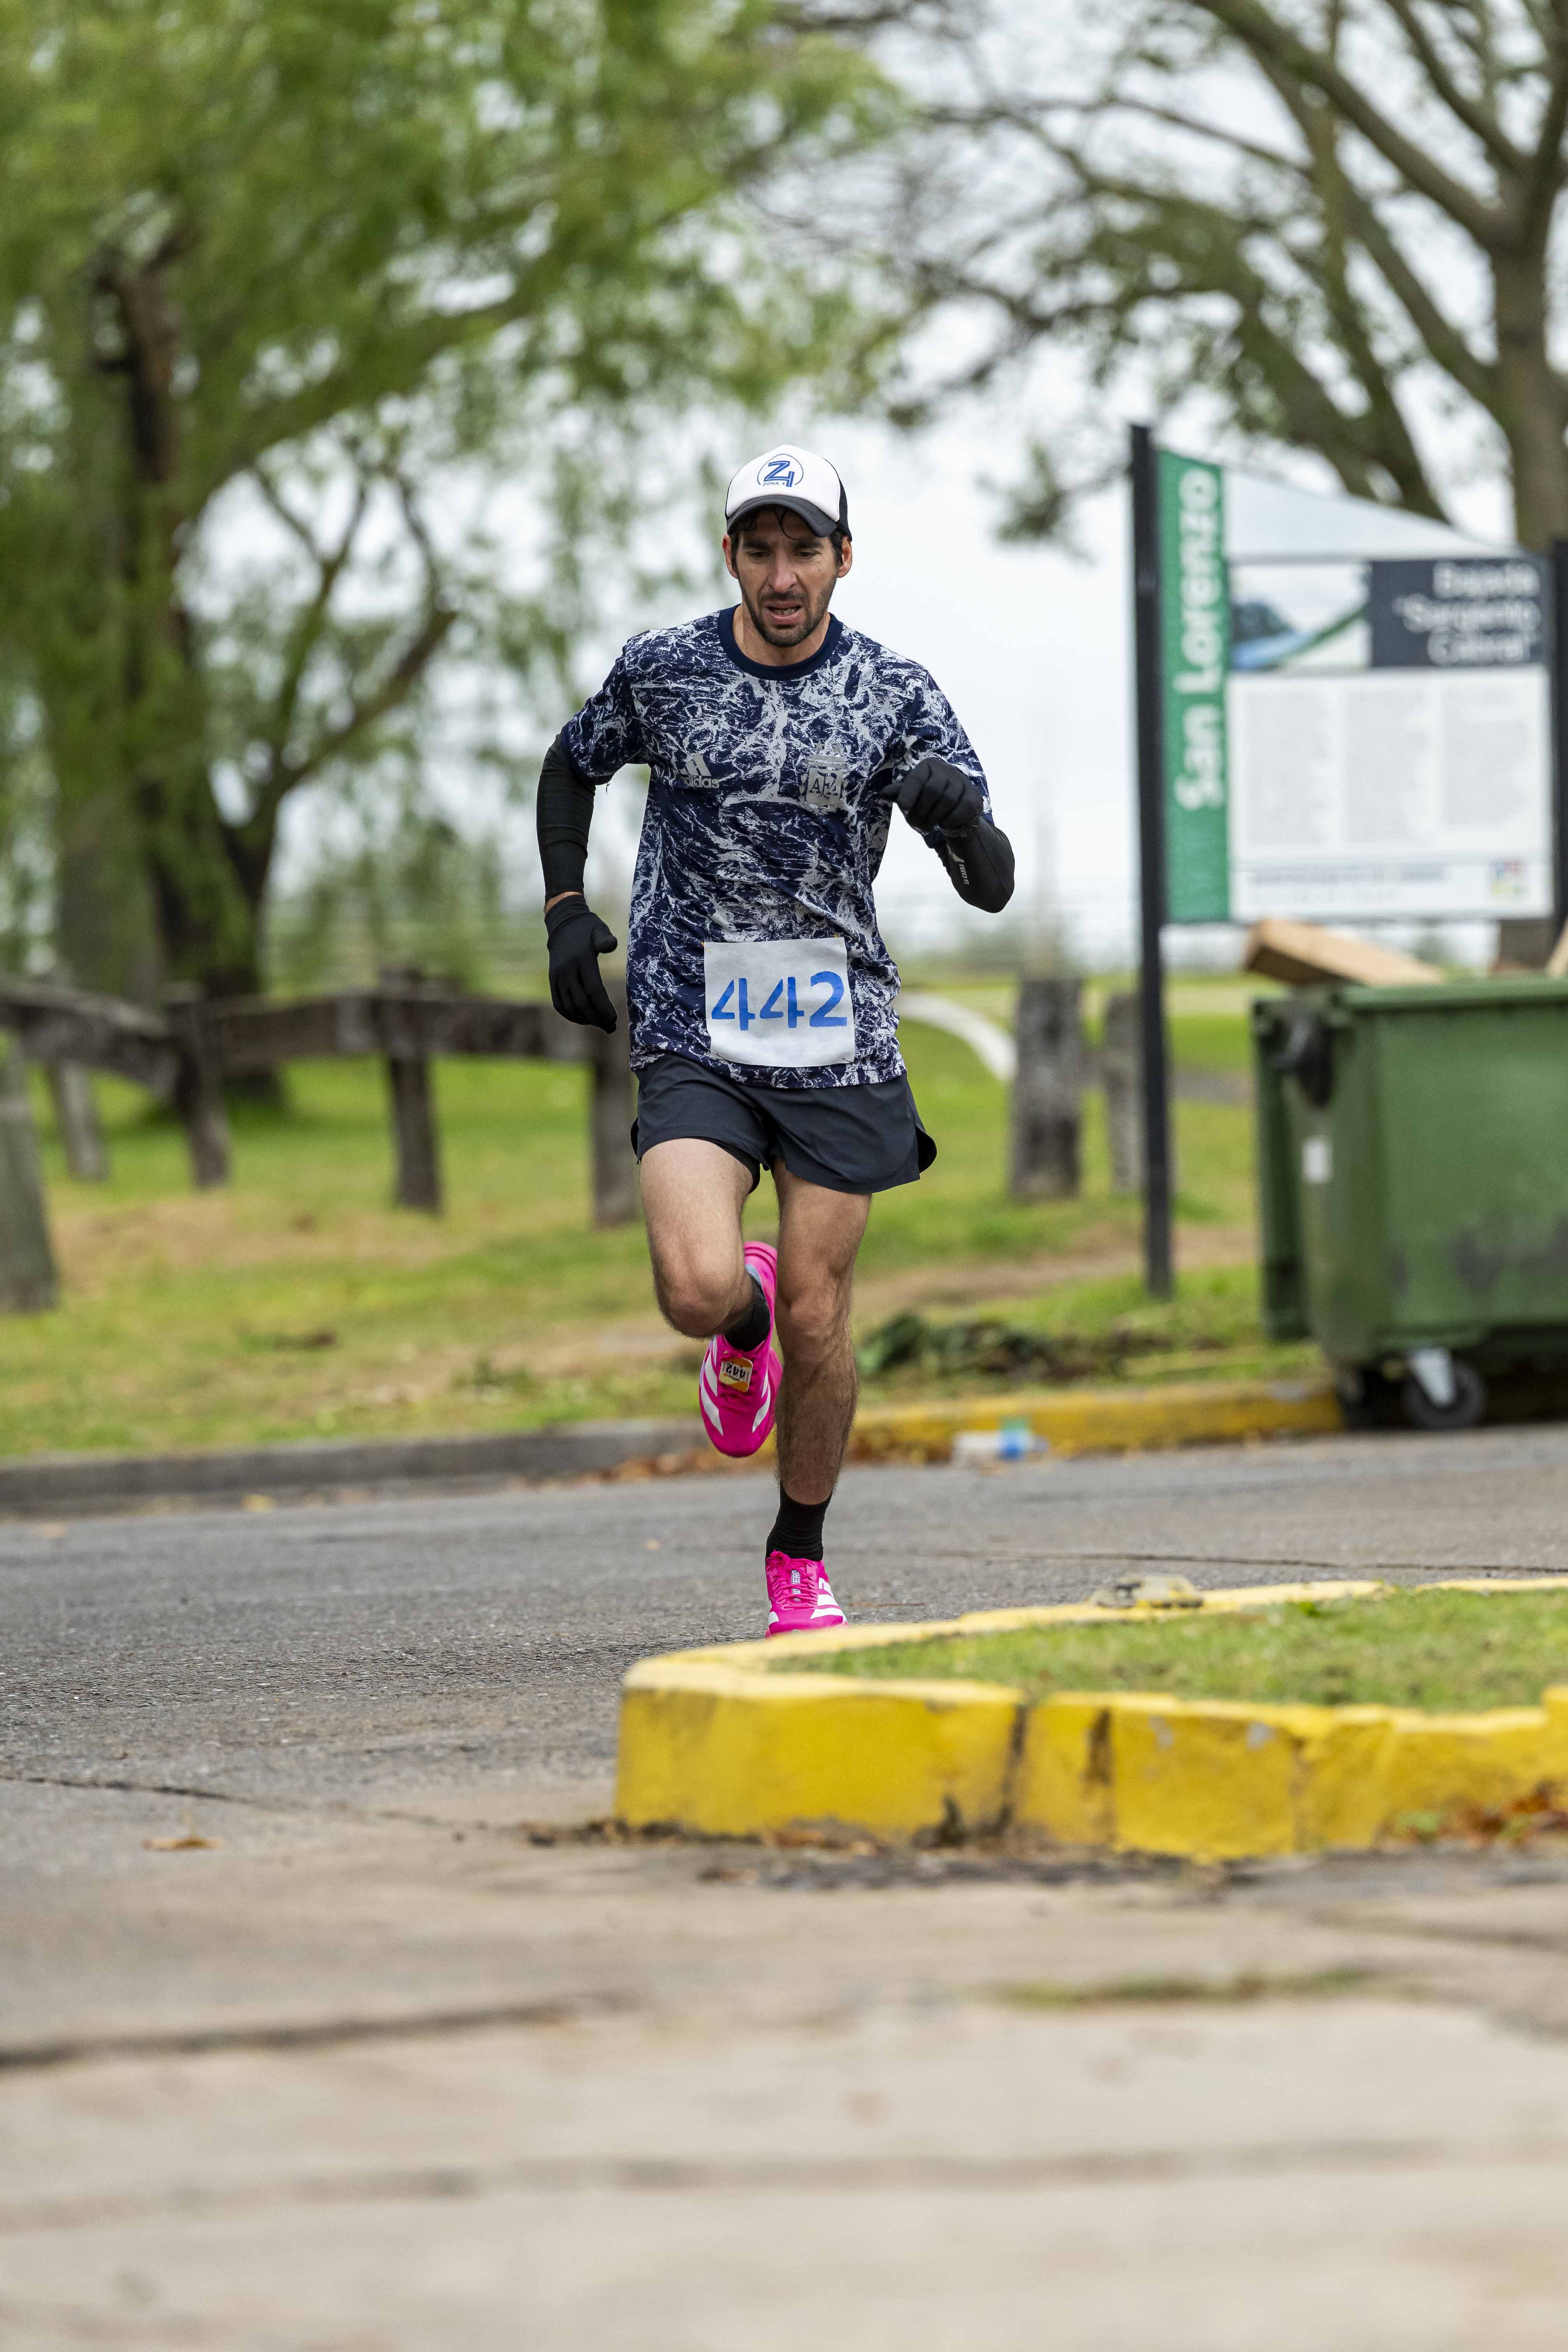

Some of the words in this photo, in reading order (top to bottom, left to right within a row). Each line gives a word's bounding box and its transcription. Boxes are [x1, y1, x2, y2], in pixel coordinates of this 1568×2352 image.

[1174, 470, 1222, 693] Lorenzo
[1174, 704, 1223, 809] San
[711, 971, 847, 1031] 442
[726, 1363, 746, 1378] 442
